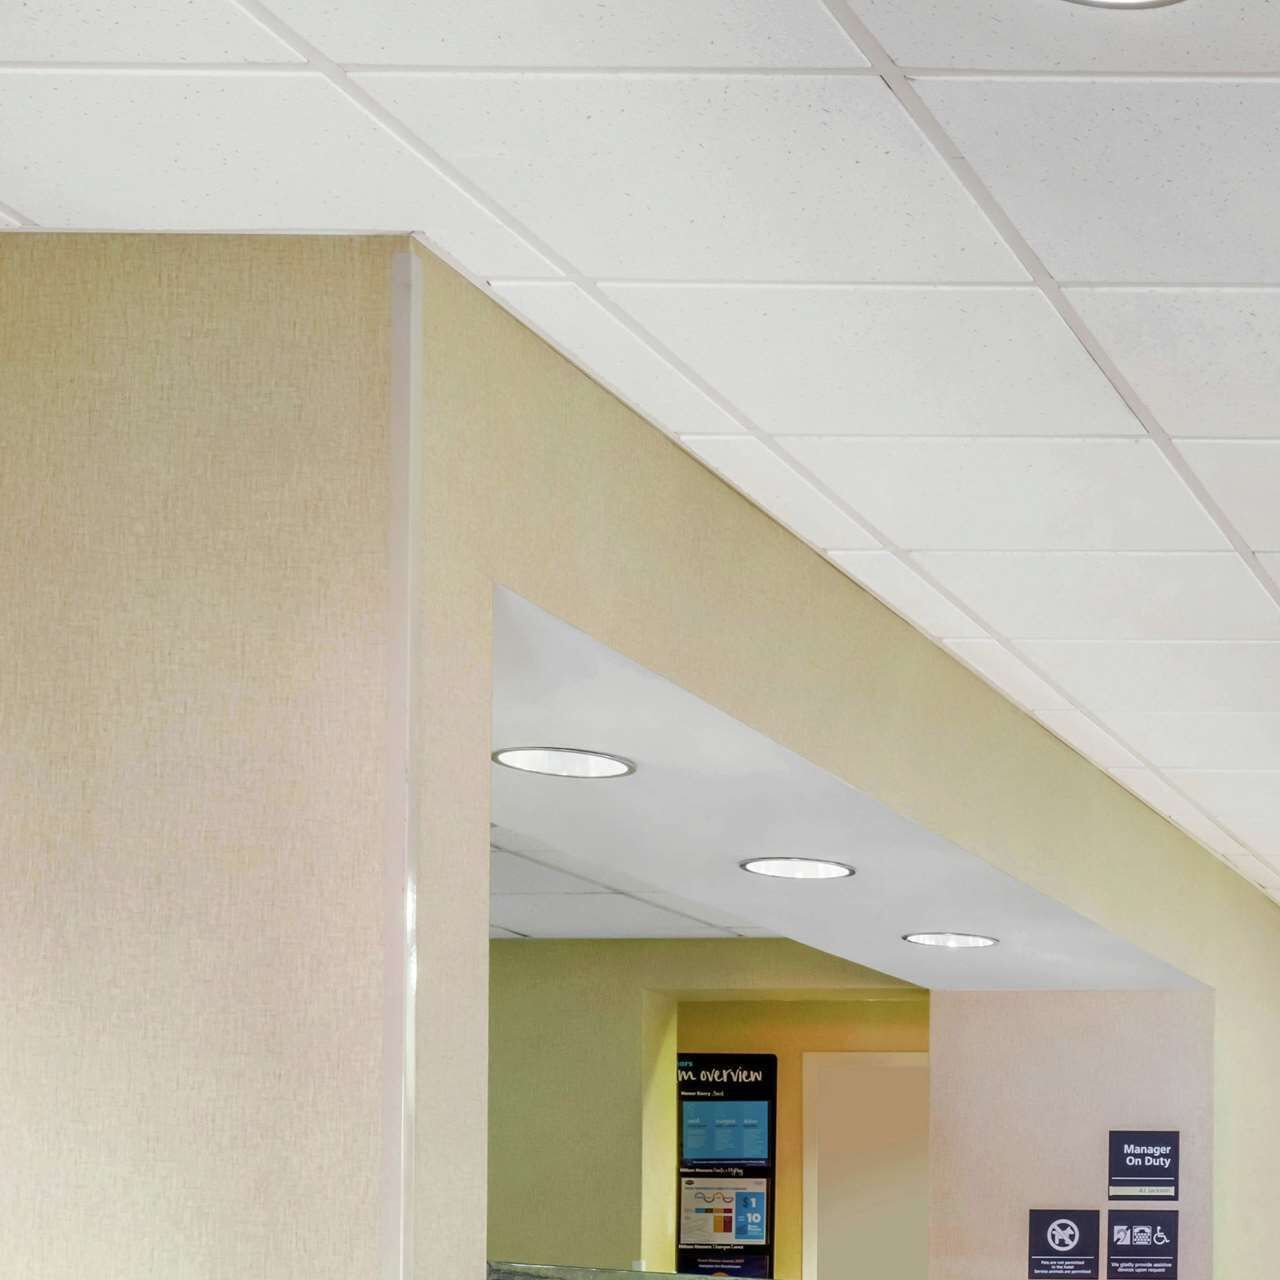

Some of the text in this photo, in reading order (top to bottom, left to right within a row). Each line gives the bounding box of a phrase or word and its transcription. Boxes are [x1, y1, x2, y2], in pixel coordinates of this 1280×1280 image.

[700, 1066, 762, 1082] overview
[1123, 1144, 1171, 1156] Manager
[1126, 1156, 1171, 1168] On Duty
[747, 1213, 762, 1223] 10
